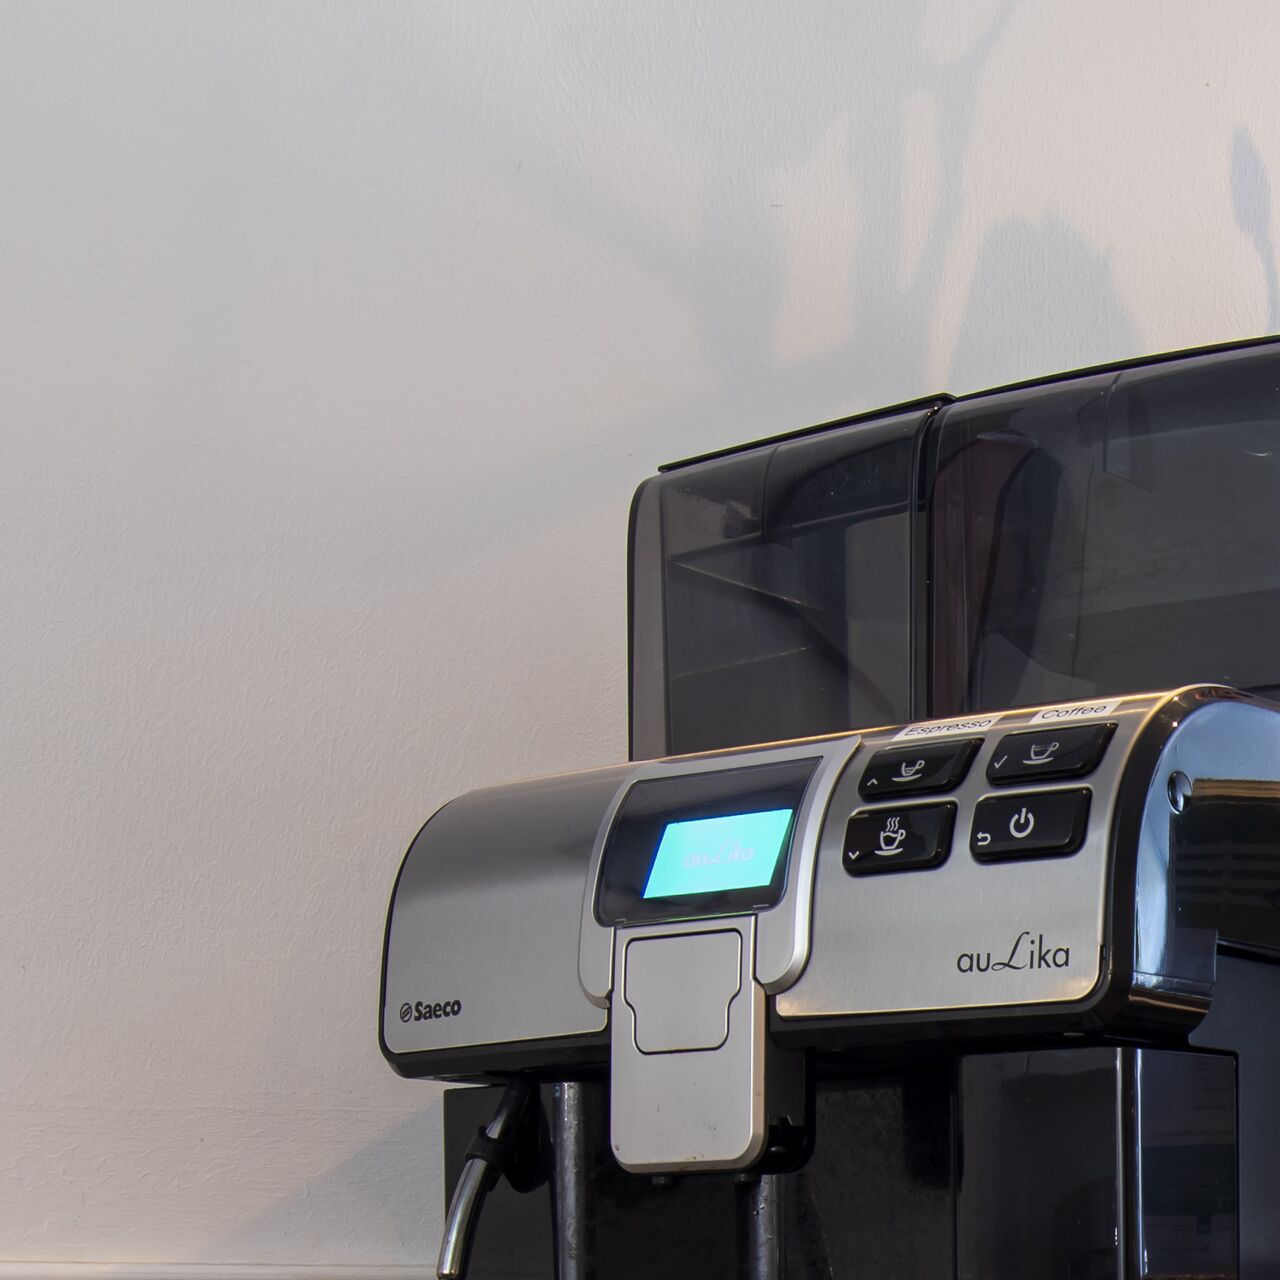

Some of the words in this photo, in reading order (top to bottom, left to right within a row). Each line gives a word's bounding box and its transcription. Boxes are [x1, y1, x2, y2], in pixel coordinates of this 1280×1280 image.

[1041, 703, 1107, 721] Coffee
[904, 719, 992, 738] Espresso
[413, 999, 462, 1021] Saeco
